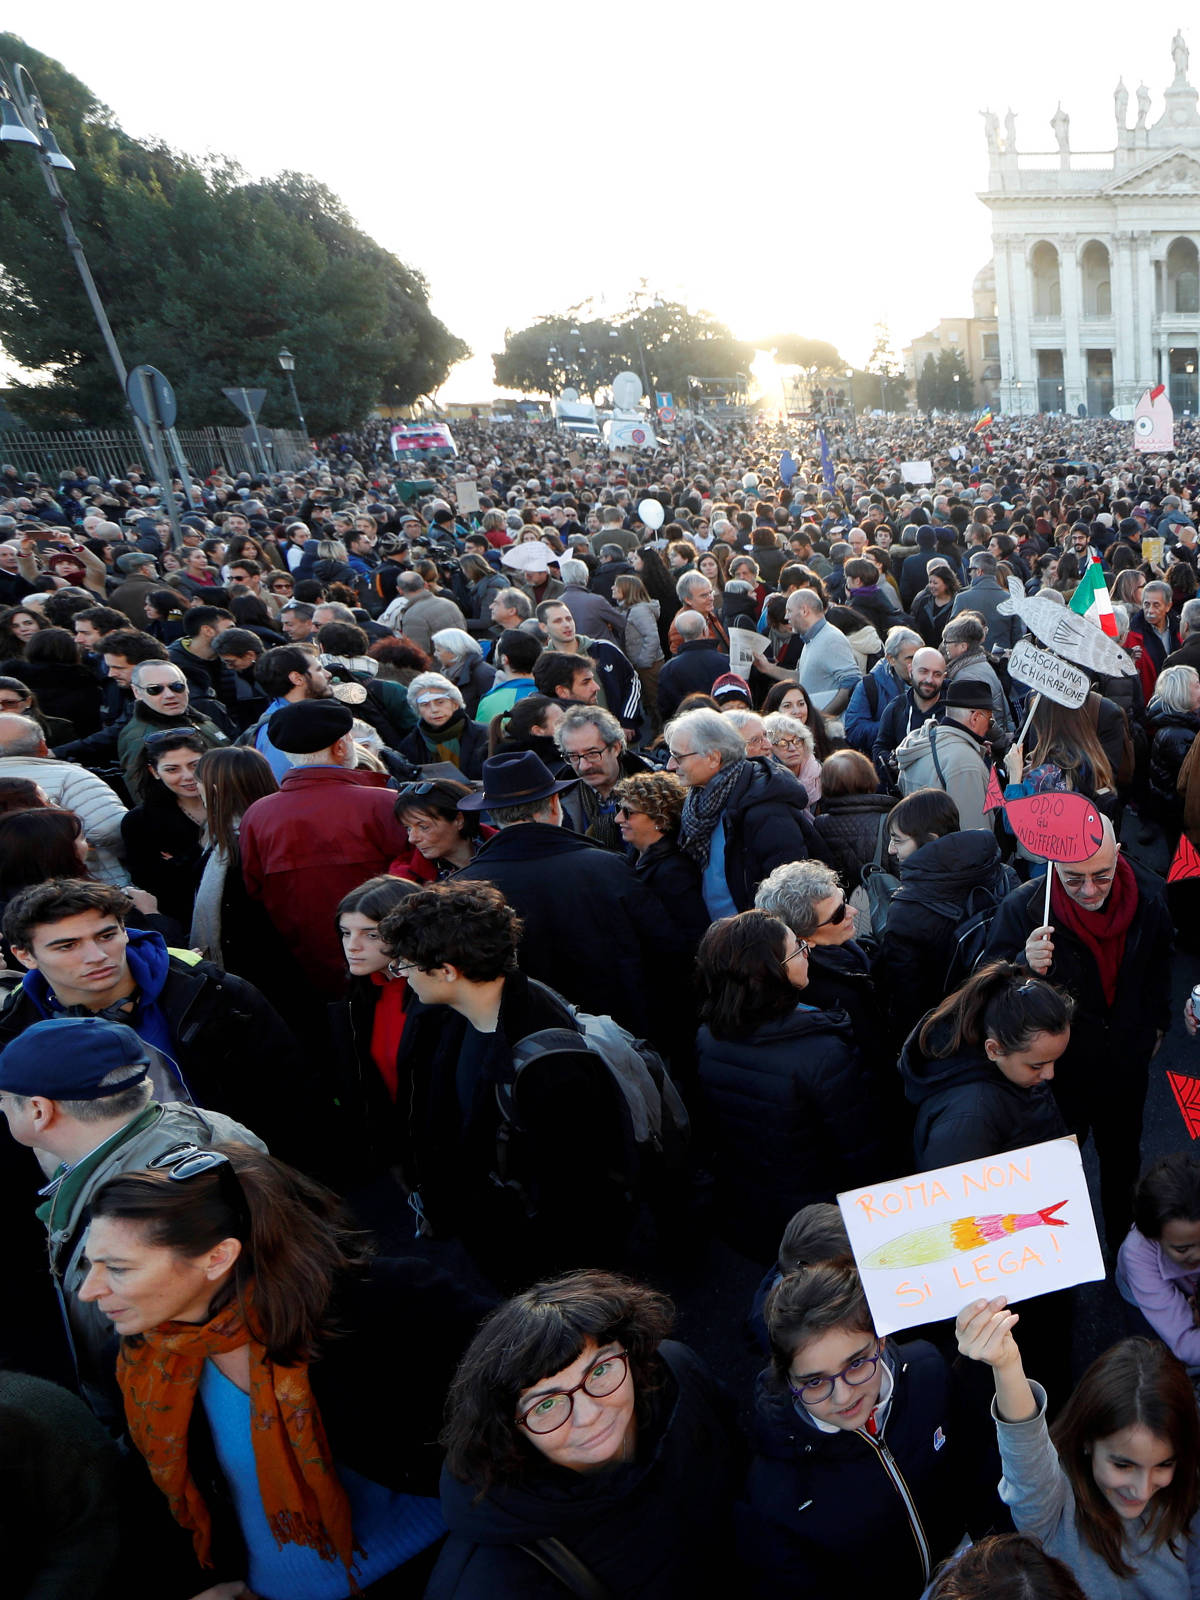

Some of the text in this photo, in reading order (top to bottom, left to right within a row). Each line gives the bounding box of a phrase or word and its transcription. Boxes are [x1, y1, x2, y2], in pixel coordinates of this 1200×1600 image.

[1010, 655, 1085, 702] DICHIARAZIONE
[1024, 647, 1082, 686] LASCIA UNA
[855, 1157, 1032, 1223] ROMA NON
